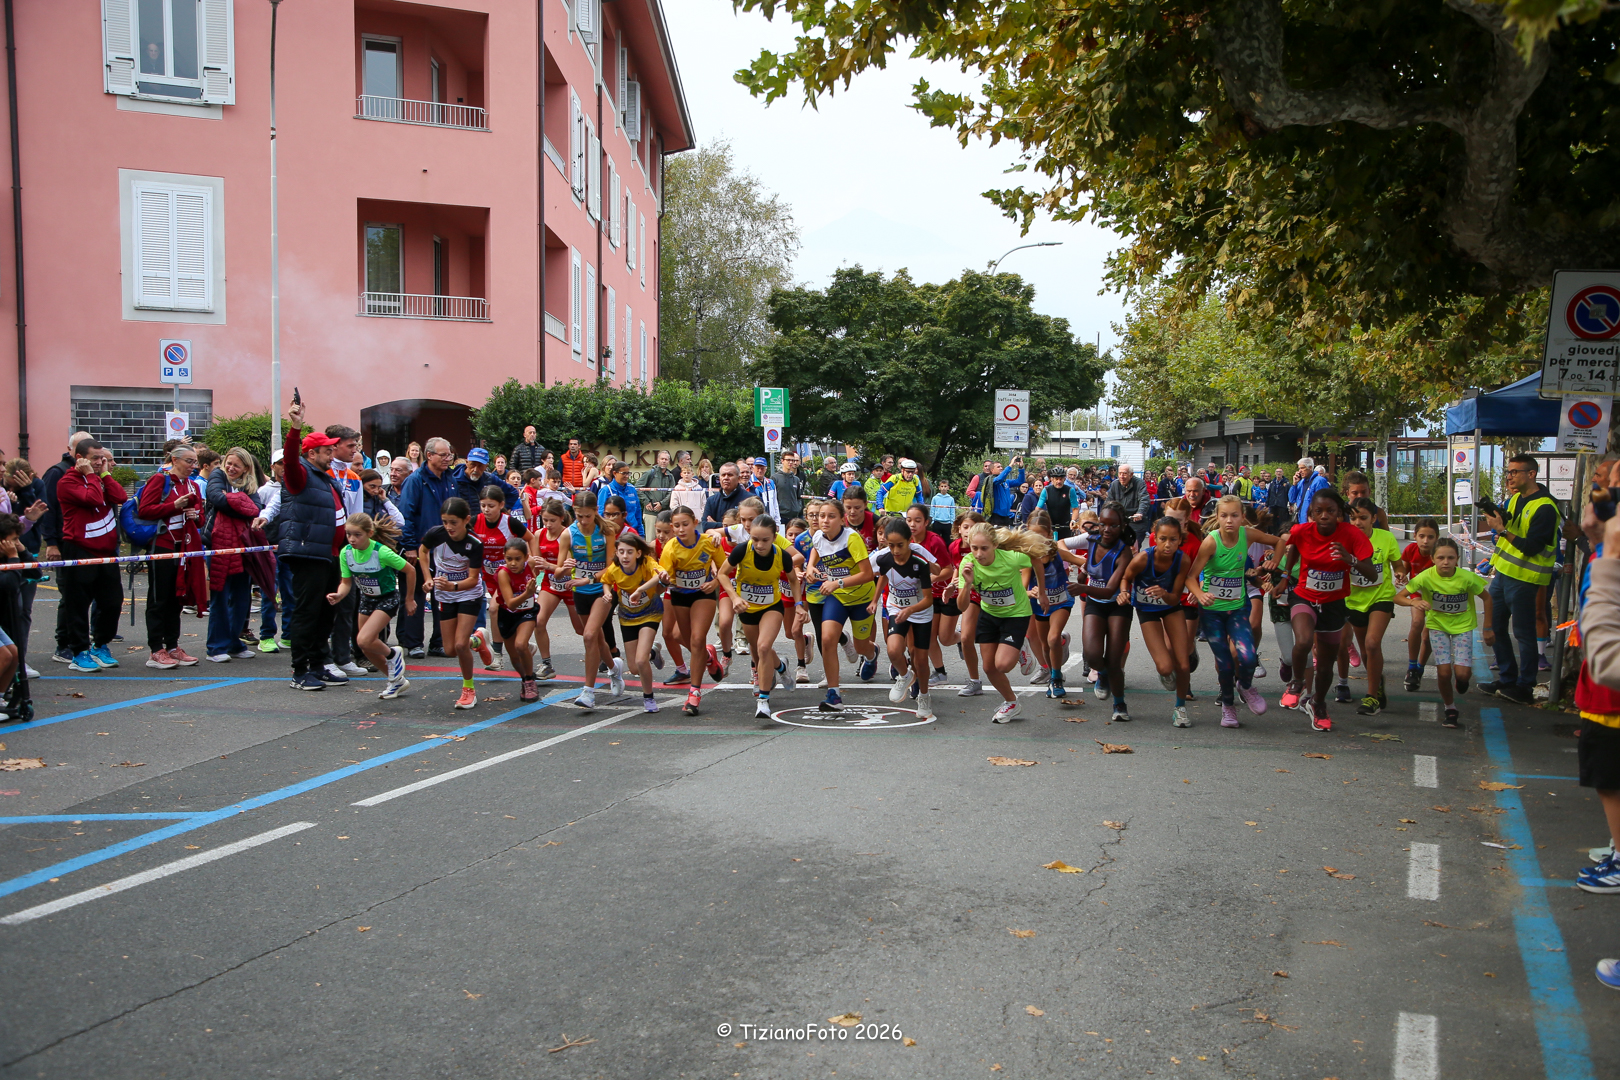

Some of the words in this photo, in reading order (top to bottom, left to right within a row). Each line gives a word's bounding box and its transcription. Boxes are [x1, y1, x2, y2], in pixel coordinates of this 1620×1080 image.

[1550, 357, 1572, 367] per
[762, 389, 772, 404] P
[682, 579, 700, 588] 149
[1313, 581, 1336, 590] 430
[747, 593, 766, 603] 277
[1218, 588, 1233, 598] 32
[893, 596, 911, 606] 348
[1440, 603, 1461, 612] 499
